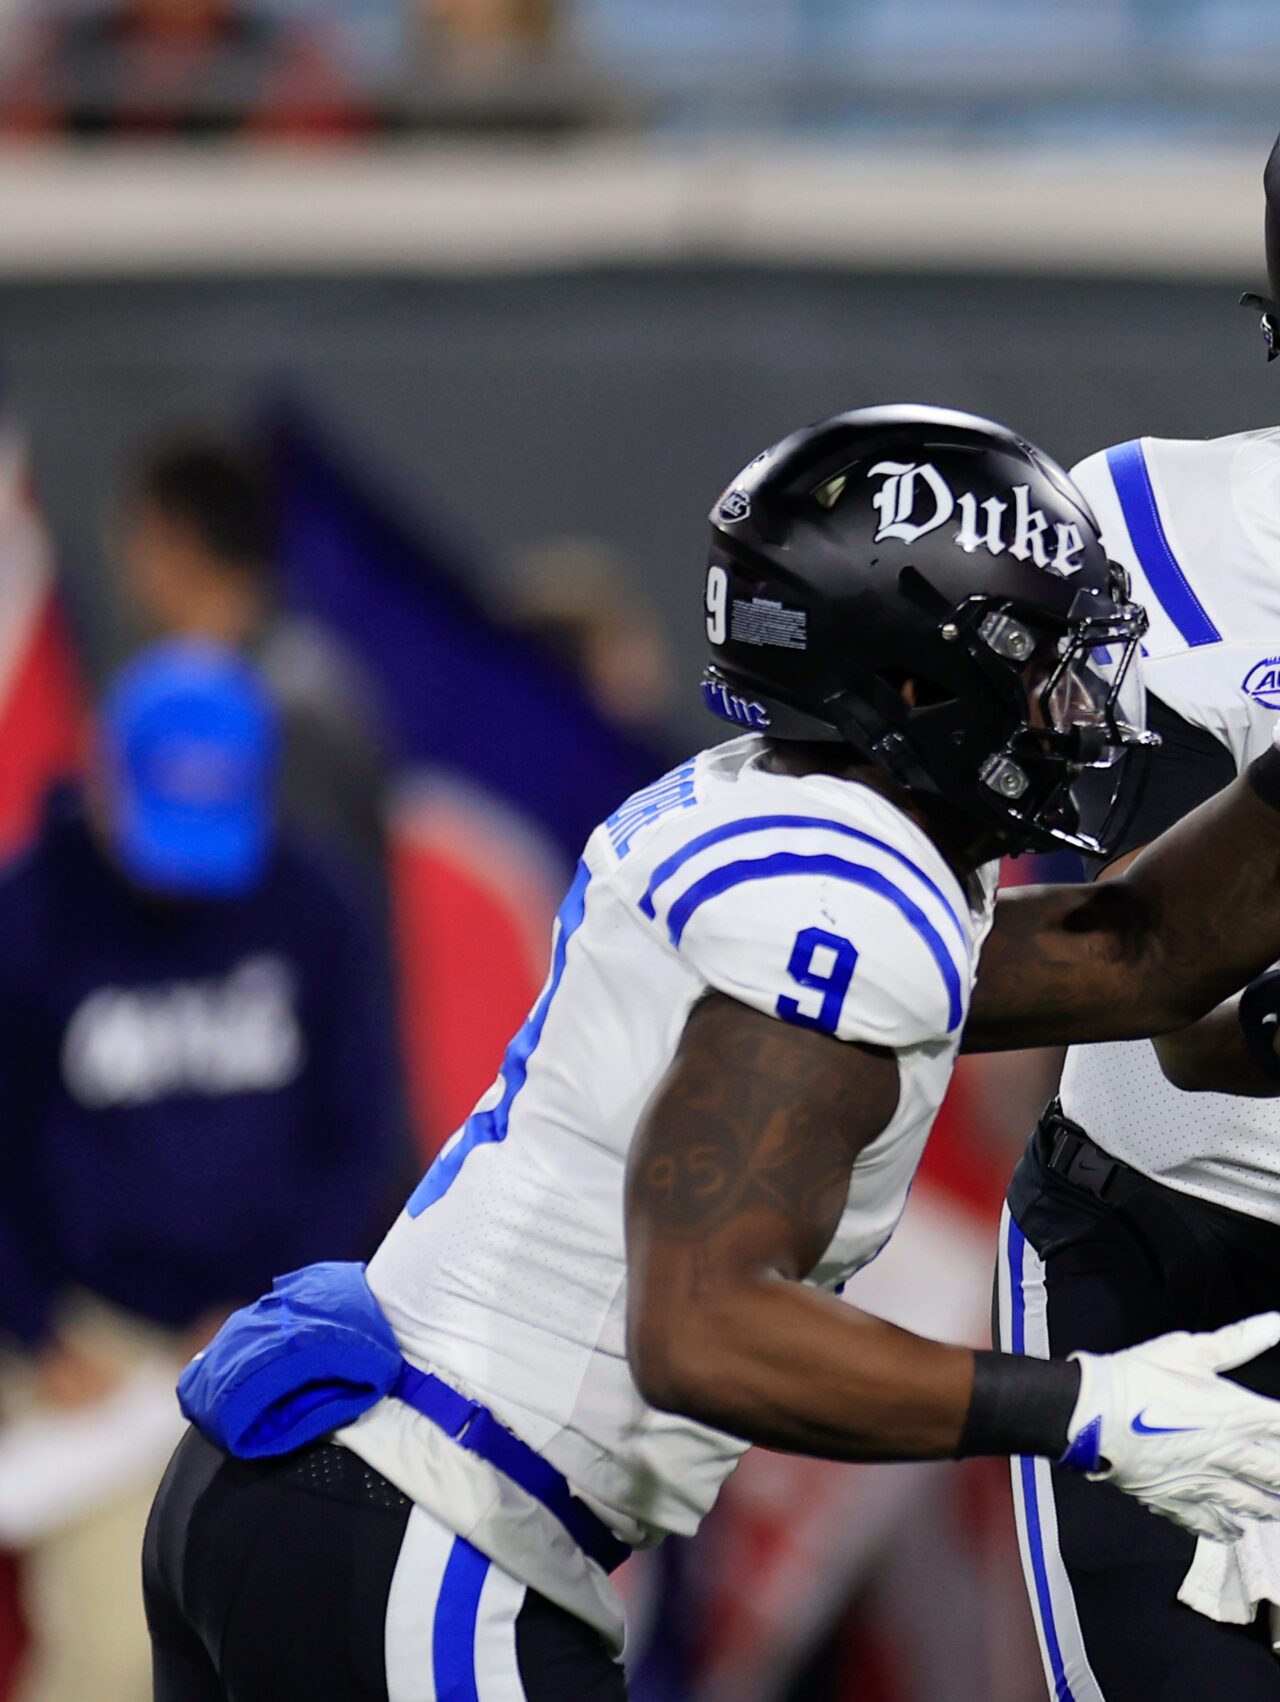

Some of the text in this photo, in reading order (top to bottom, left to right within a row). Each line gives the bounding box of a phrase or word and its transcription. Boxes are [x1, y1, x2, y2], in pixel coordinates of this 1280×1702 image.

[867, 460, 1086, 578] Duke
[706, 566, 728, 645] 9
[775, 927, 859, 1034] 9
